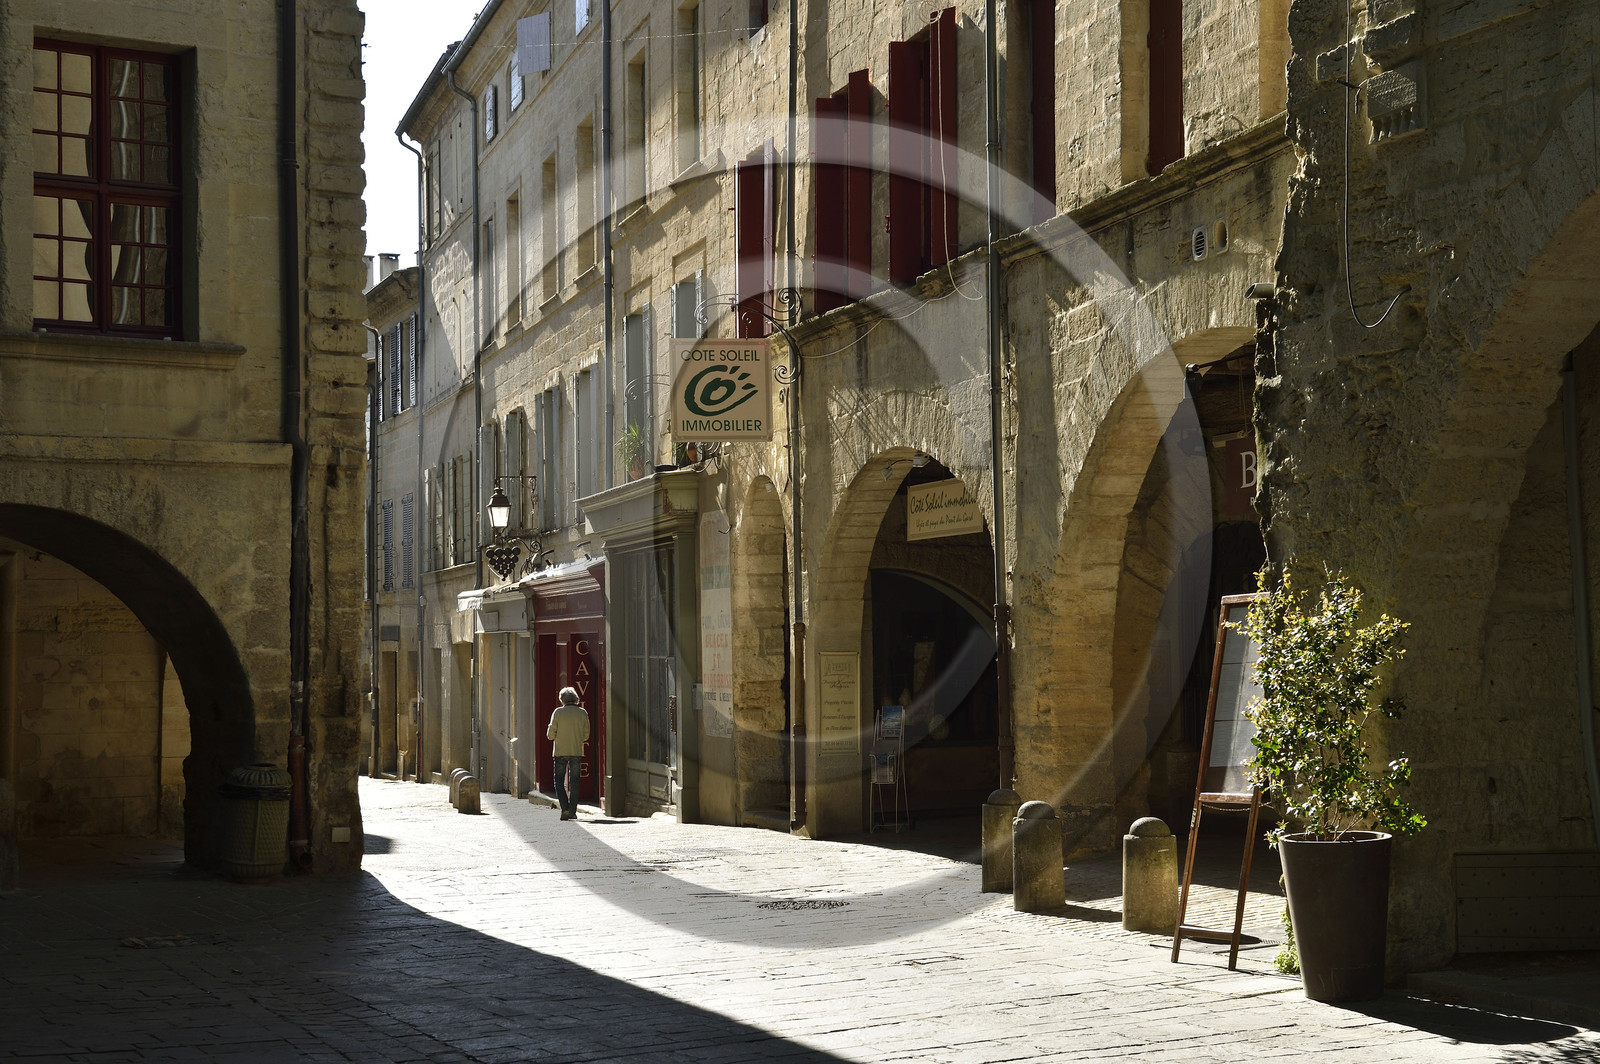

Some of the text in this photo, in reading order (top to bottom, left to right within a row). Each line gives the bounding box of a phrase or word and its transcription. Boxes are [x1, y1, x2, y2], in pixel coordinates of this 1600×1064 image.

[681, 350, 760, 361] COTE SOLEIL
[682, 420, 762, 431] IMMOBILIER
[925, 491, 944, 512] Soleil
